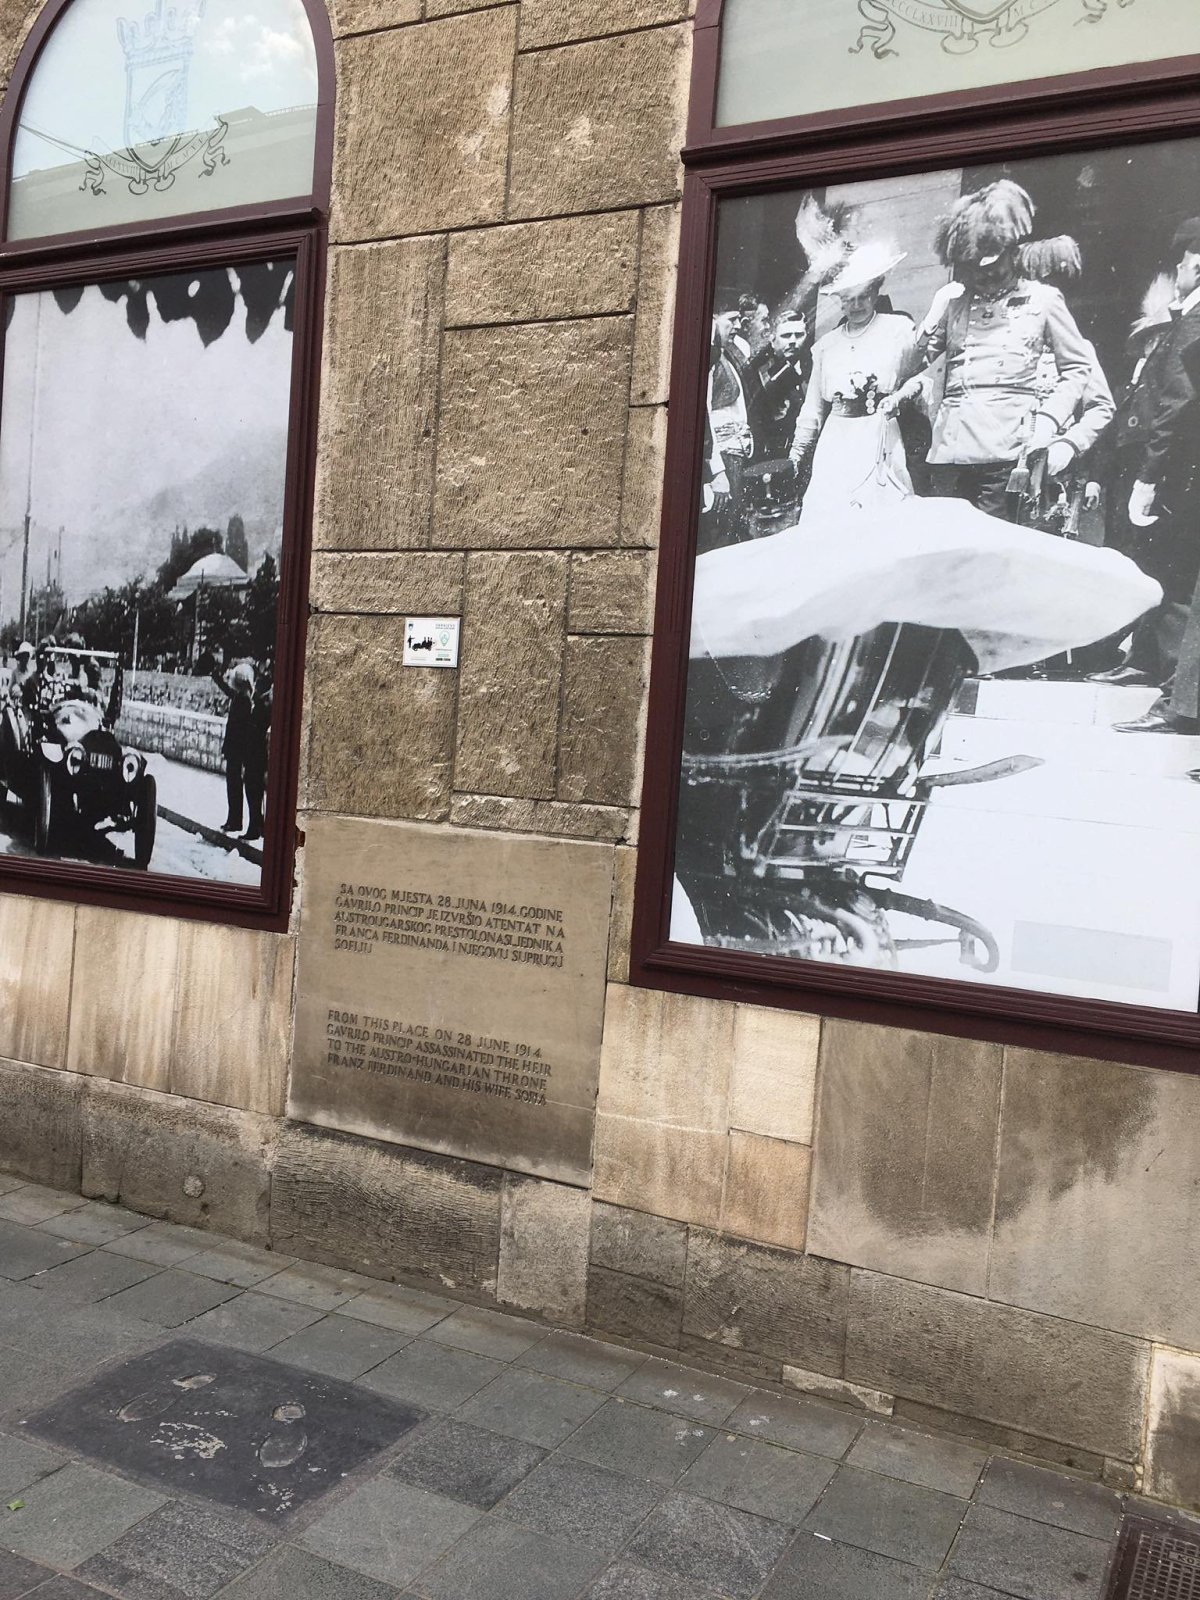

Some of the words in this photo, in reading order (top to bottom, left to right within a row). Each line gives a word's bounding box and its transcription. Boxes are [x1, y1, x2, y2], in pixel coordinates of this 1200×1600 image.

[340, 883, 354, 896] SA
[358, 886, 387, 900] OVOG
[391, 889, 433, 905] MJESTA
[334, 911, 432, 934] AUSTROUGARSKOG
[434, 923, 564, 953] PRESTOLONASLJEDNIKA
[335, 896, 381, 912] GAVRILO
[384, 903, 425, 918] PRINCIP
[426, 908, 439, 920] JE
[484, 917, 542, 934] ATENTAT
[546, 924, 565, 938] NA
[335, 924, 379, 941] FRANCA
[382, 931, 450, 952] FERDINANDA
[459, 942, 509, 960] NJEGOVU
[511, 950, 564, 968] SUPRUGU
[335, 938, 373, 954] SOFIJU
[327, 1023, 370, 1041] GAVRILO
[373, 1031, 413, 1048] PRINCIP
[416, 1041, 494, 1065] ASSASSINATED
[496, 1055, 520, 1071] THE
[522, 1059, 552, 1077] HEIR
[328, 1009, 358, 1025] FROM
[363, 1016, 390, 1031] THIS
[392, 1021, 429, 1038] PLACE
[435, 1028, 453, 1041] ON
[457, 1032, 472, 1046] 28
[477, 1036, 510, 1054] JUNE
[515, 1043, 542, 1059] 1914
[327, 1052, 365, 1070] FRANZ
[367, 1060, 432, 1084] FERDINAND
[434, 1073, 460, 1089] AND
[462, 1078, 481, 1093] HIS
[484, 1081, 512, 1099] WIFE
[328, 1038, 342, 1051] TO
[345, 1041, 366, 1056] THE
[369, 1046, 491, 1080] AUSTRO-HUNGARIAN
[494, 1069, 547, 1091] THRONE
